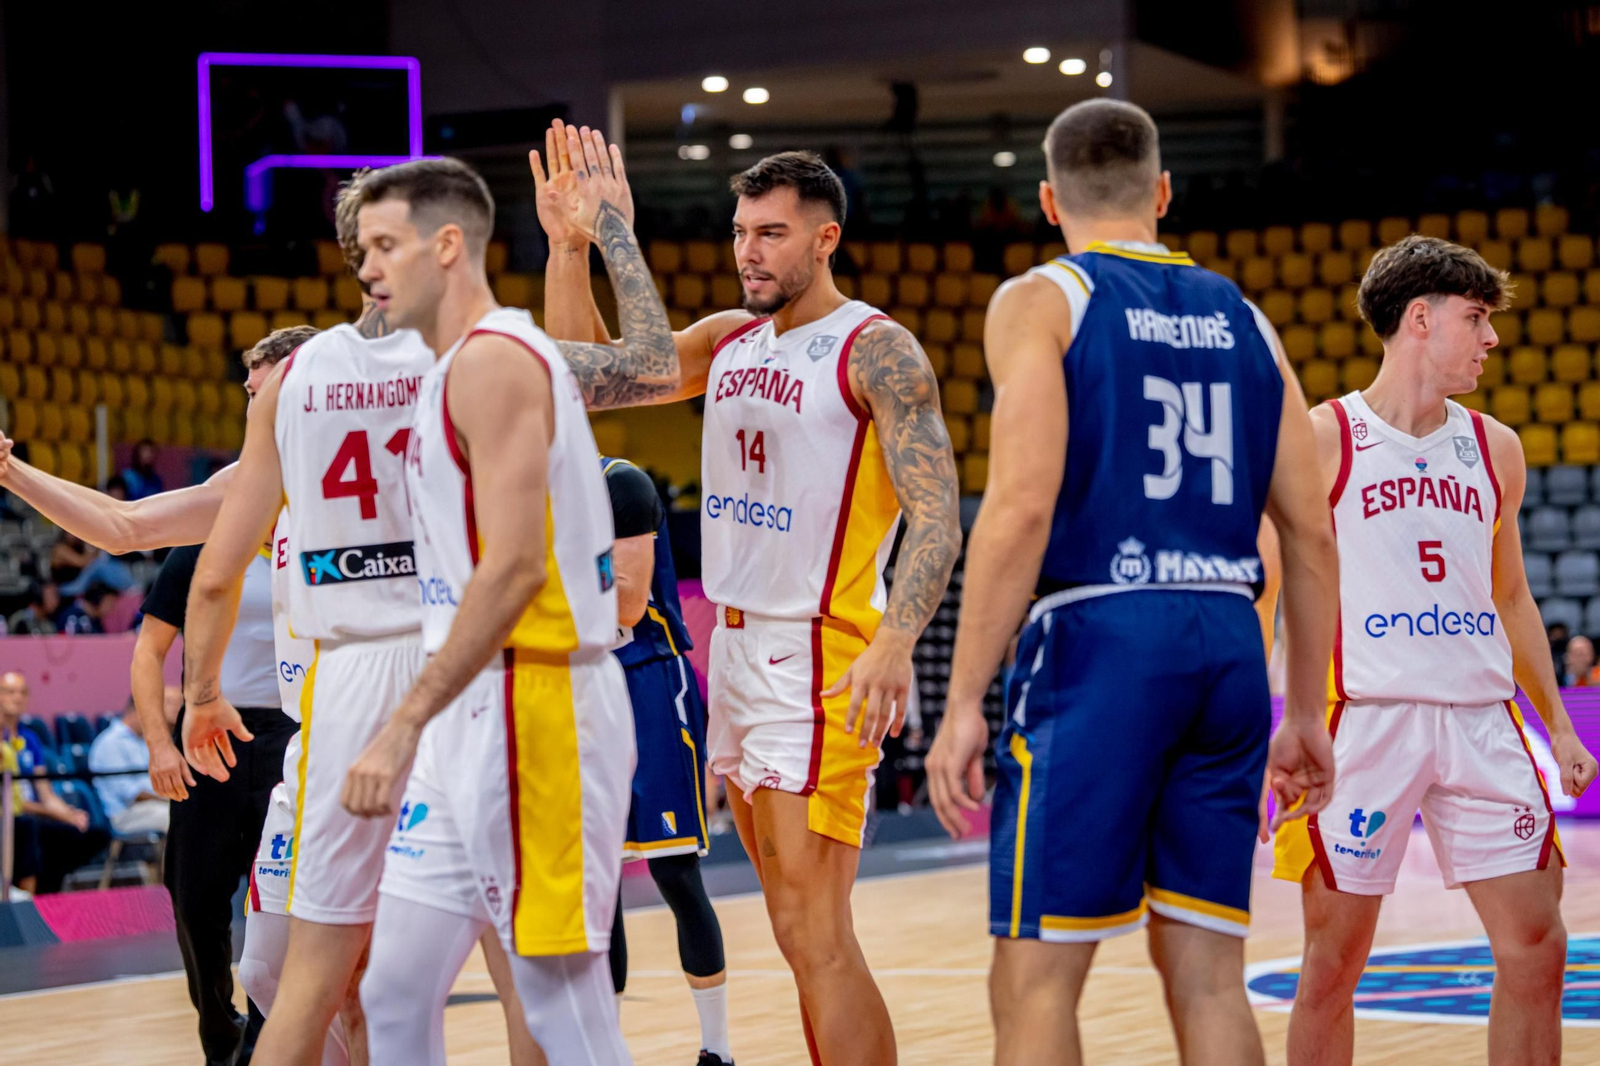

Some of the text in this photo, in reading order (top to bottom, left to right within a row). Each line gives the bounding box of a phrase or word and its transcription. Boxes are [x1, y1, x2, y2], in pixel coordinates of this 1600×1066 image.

[303, 385, 318, 413] J.
[715, 367, 804, 415] ESPAÑA
[735, 429, 766, 474] 14
[1143, 375, 1234, 505] 34
[706, 493, 792, 532] endesa
[1361, 474, 1484, 523] ESPAÑA
[338, 546, 417, 579] Caixa
[1417, 541, 1446, 582] 5
[1365, 604, 1496, 638] endesa
